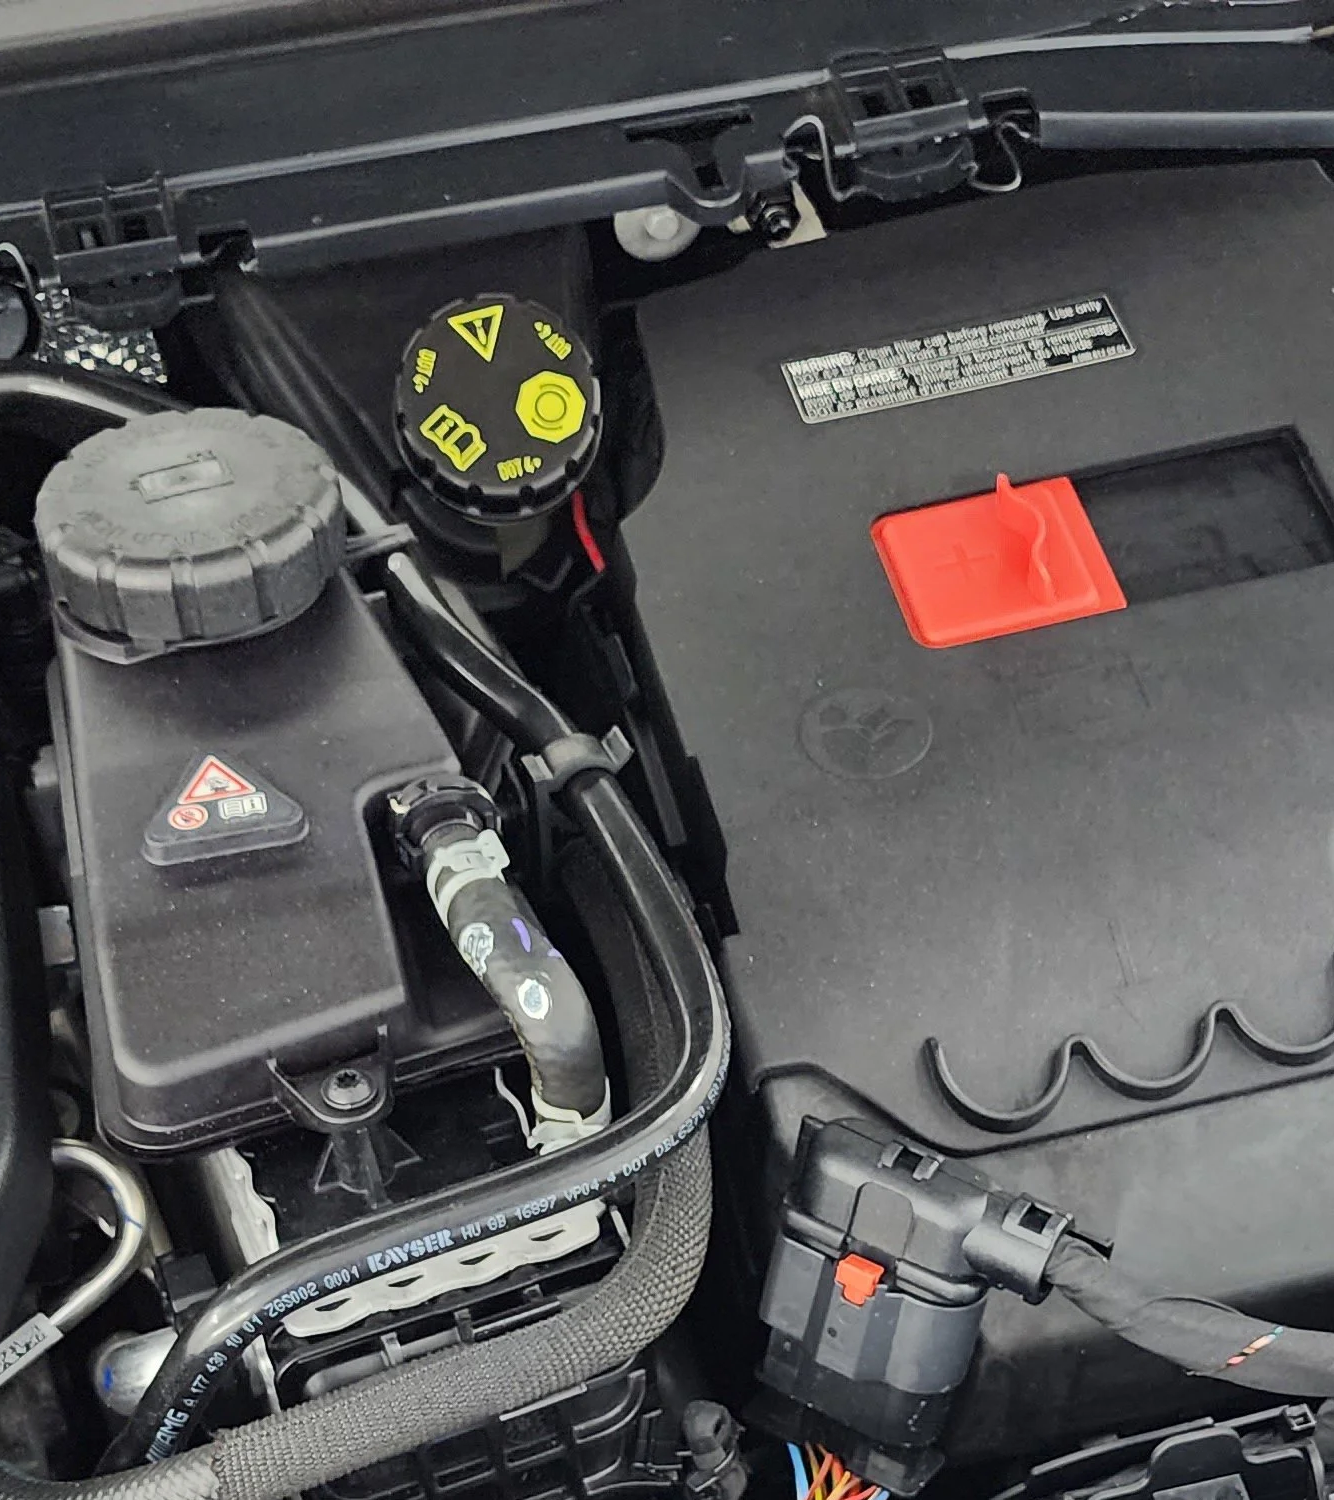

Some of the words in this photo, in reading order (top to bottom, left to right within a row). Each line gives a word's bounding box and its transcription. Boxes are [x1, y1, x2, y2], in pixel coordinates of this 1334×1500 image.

[191, 1374, 210, 1395] 177
[366, 1228, 455, 1274] KAYSER
[514, 1194, 557, 1221] 16897
